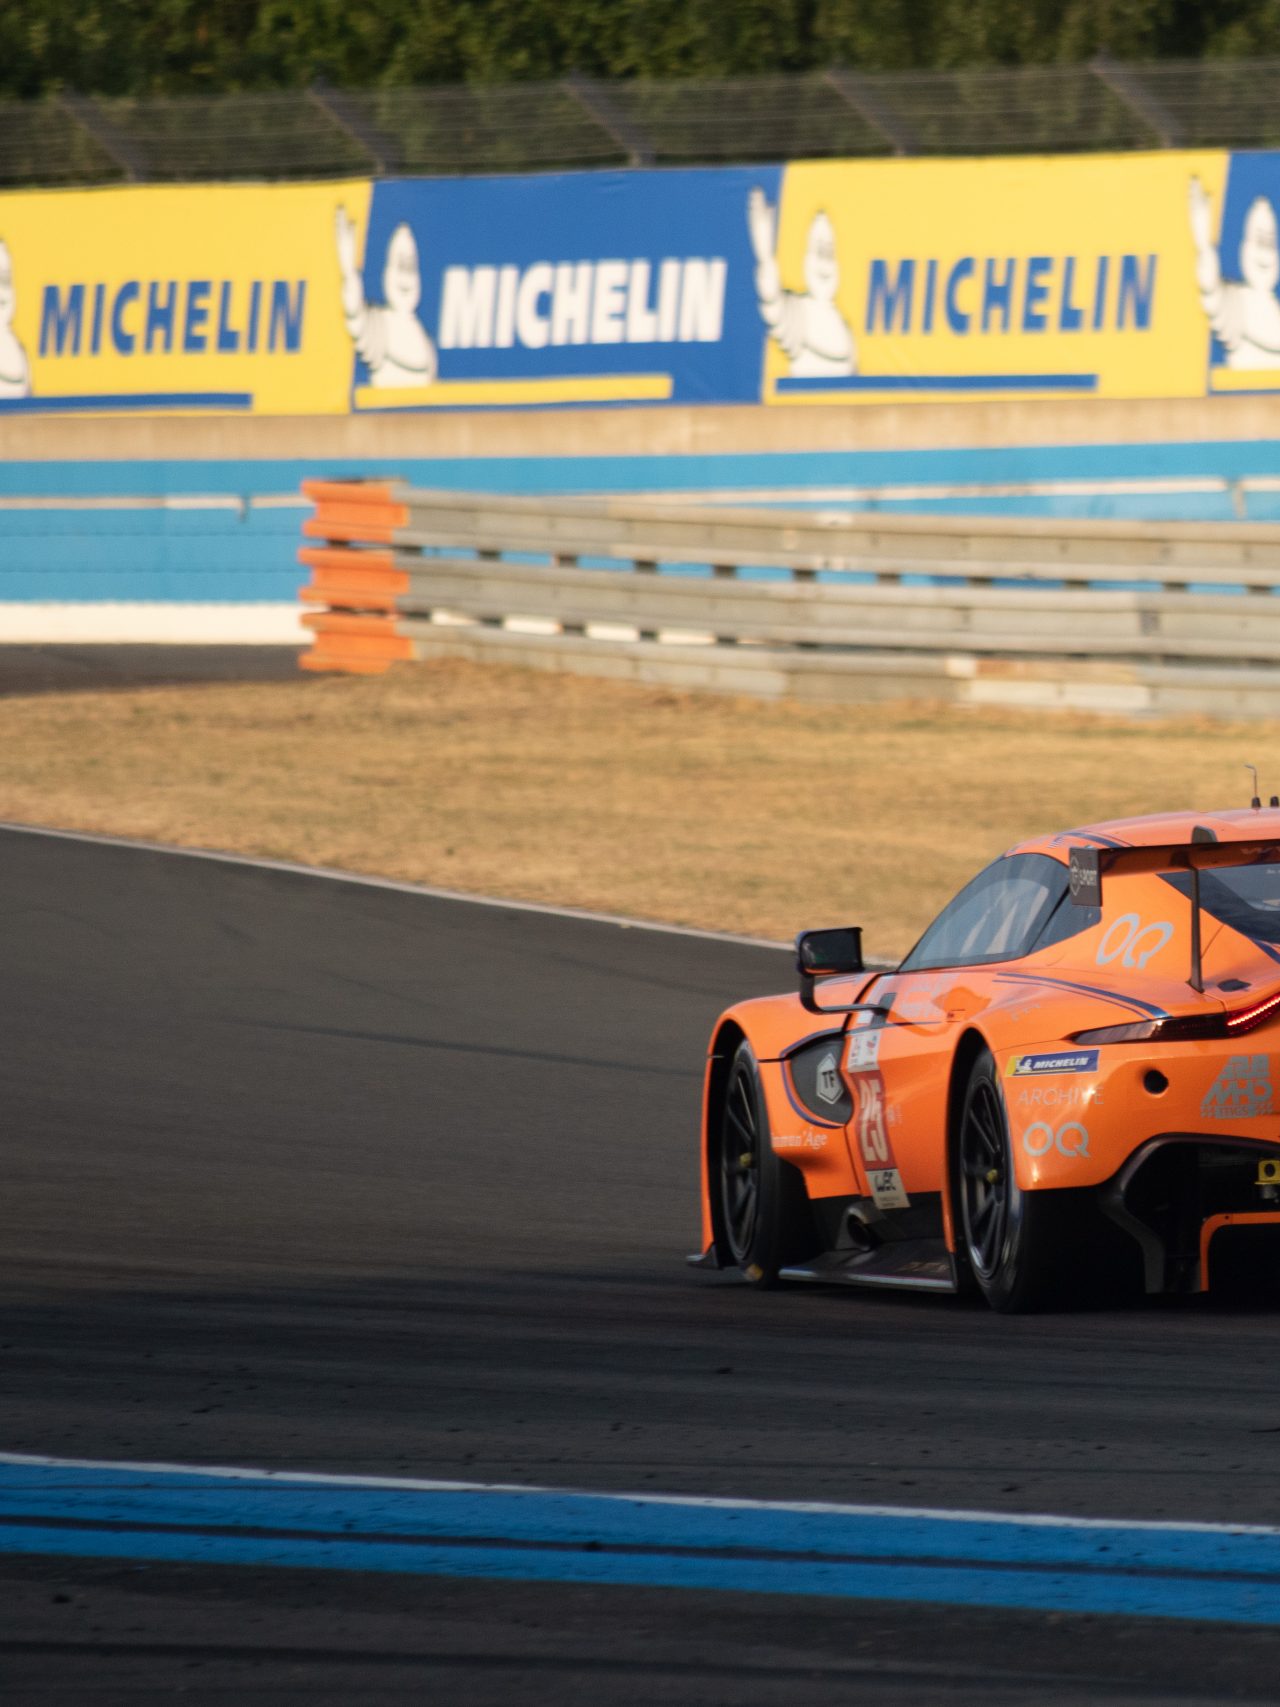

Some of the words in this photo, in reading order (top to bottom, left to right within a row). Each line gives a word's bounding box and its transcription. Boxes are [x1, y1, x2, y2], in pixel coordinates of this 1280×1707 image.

[39, 280, 306, 358] MICHELIN
[437, 257, 728, 350] MICHELIN
[867, 254, 1155, 335] MICHELIN
[1096, 912, 1174, 970] OQ
[821, 1070, 835, 1089] TF
[1033, 1056, 1090, 1070] MICHELIN
[859, 1079, 889, 1162] 25
[1018, 1087, 1105, 1106] ARCHIVE
[1023, 1121, 1092, 1158] OQ
